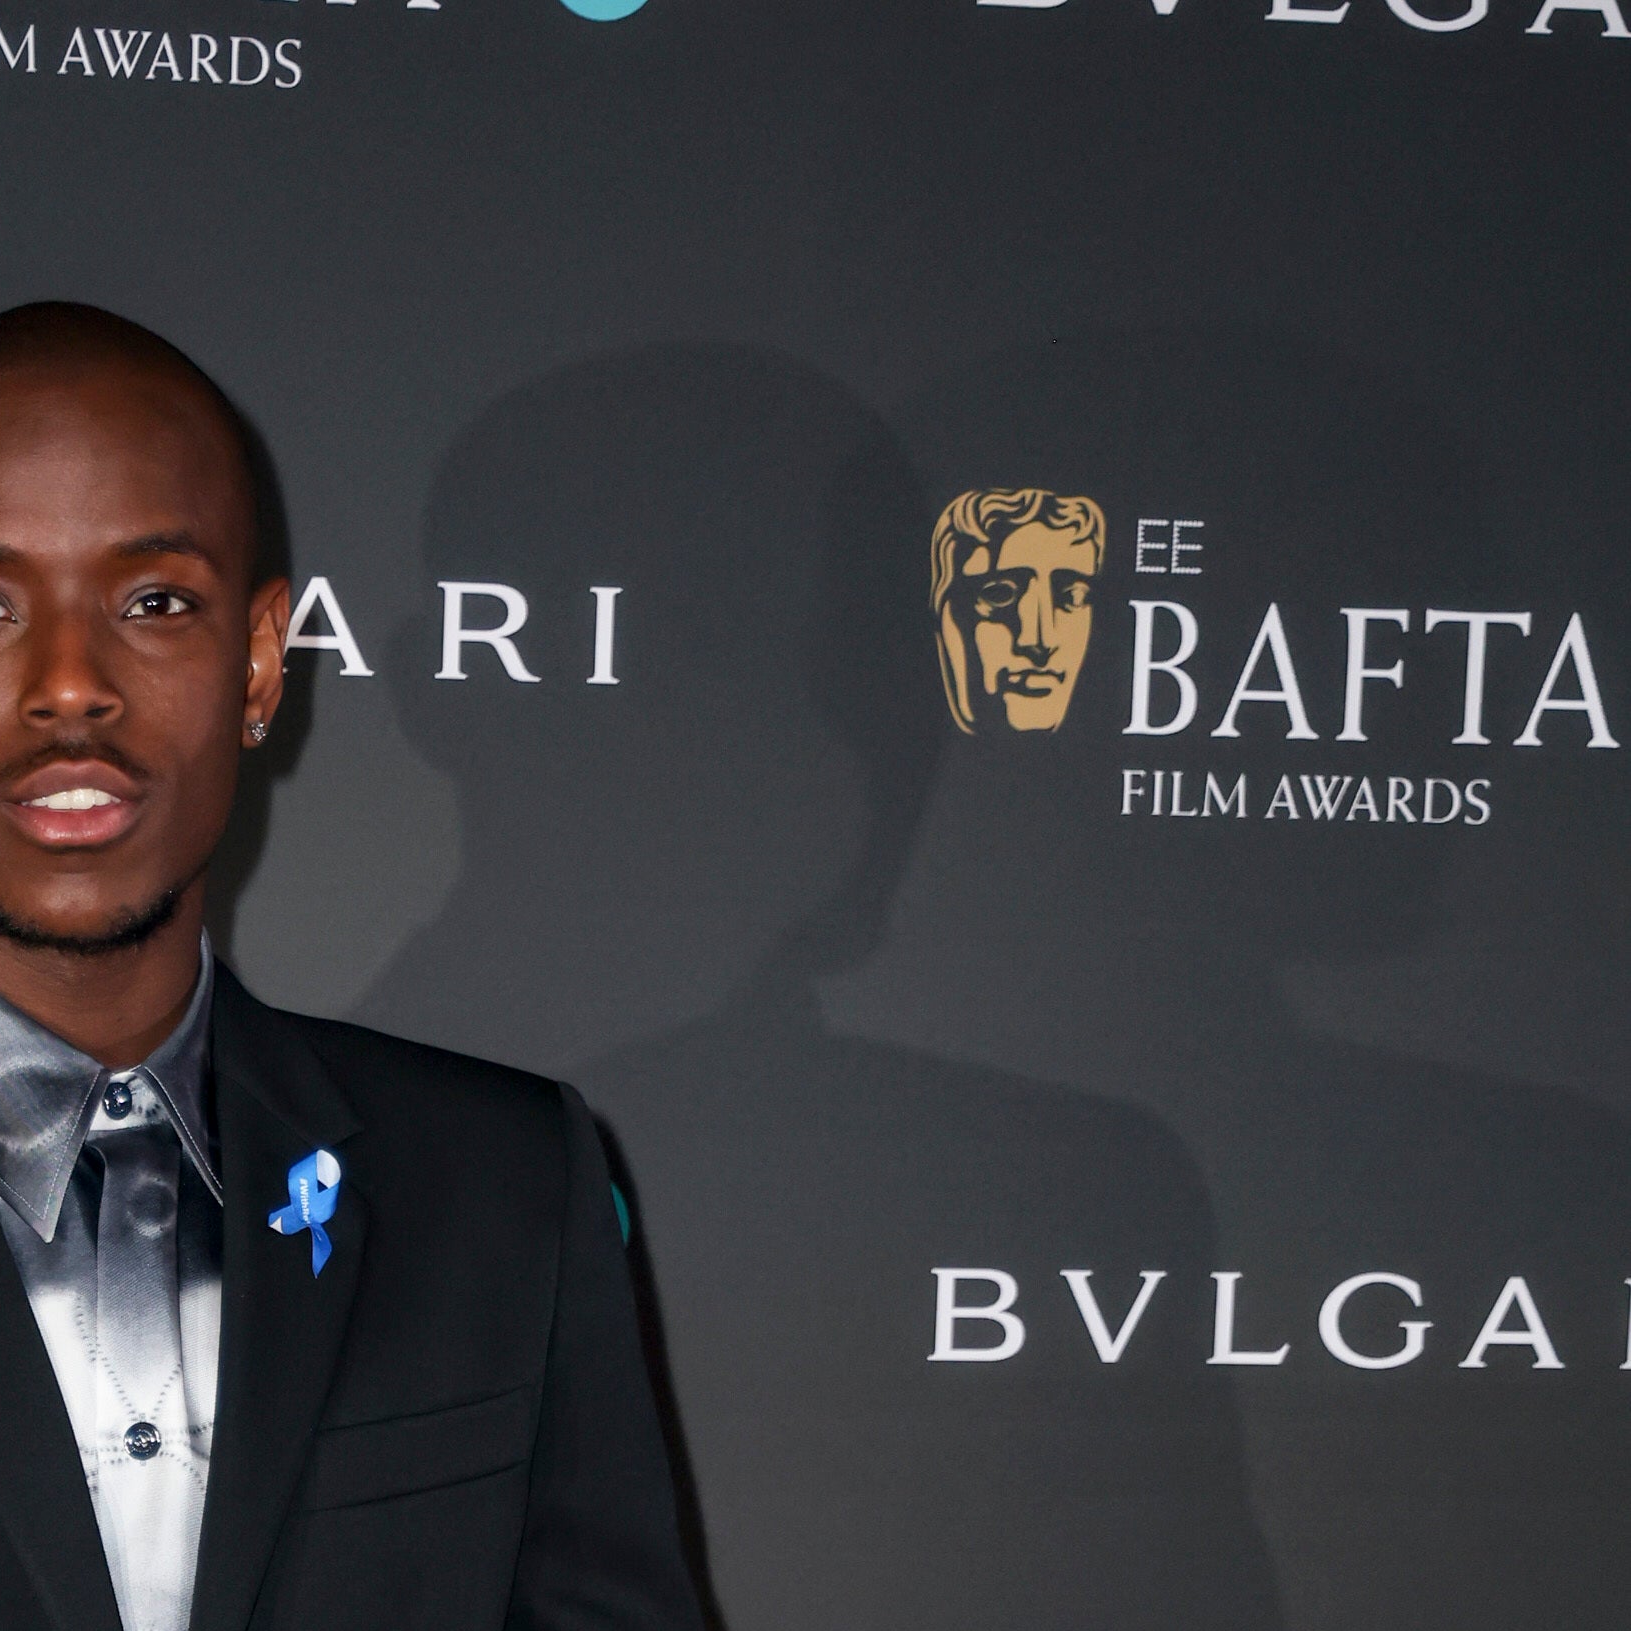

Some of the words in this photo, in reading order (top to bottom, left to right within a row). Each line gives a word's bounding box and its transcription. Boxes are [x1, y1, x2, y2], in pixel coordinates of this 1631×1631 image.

[58, 28, 301, 87] AWARDS
[1136, 519, 1204, 574] EE
[1123, 600, 1619, 748] BAFTA
[1122, 770, 1245, 817] FILM
[1265, 775, 1490, 824] AWARDS
[927, 1268, 1631, 1369] BVLGA
